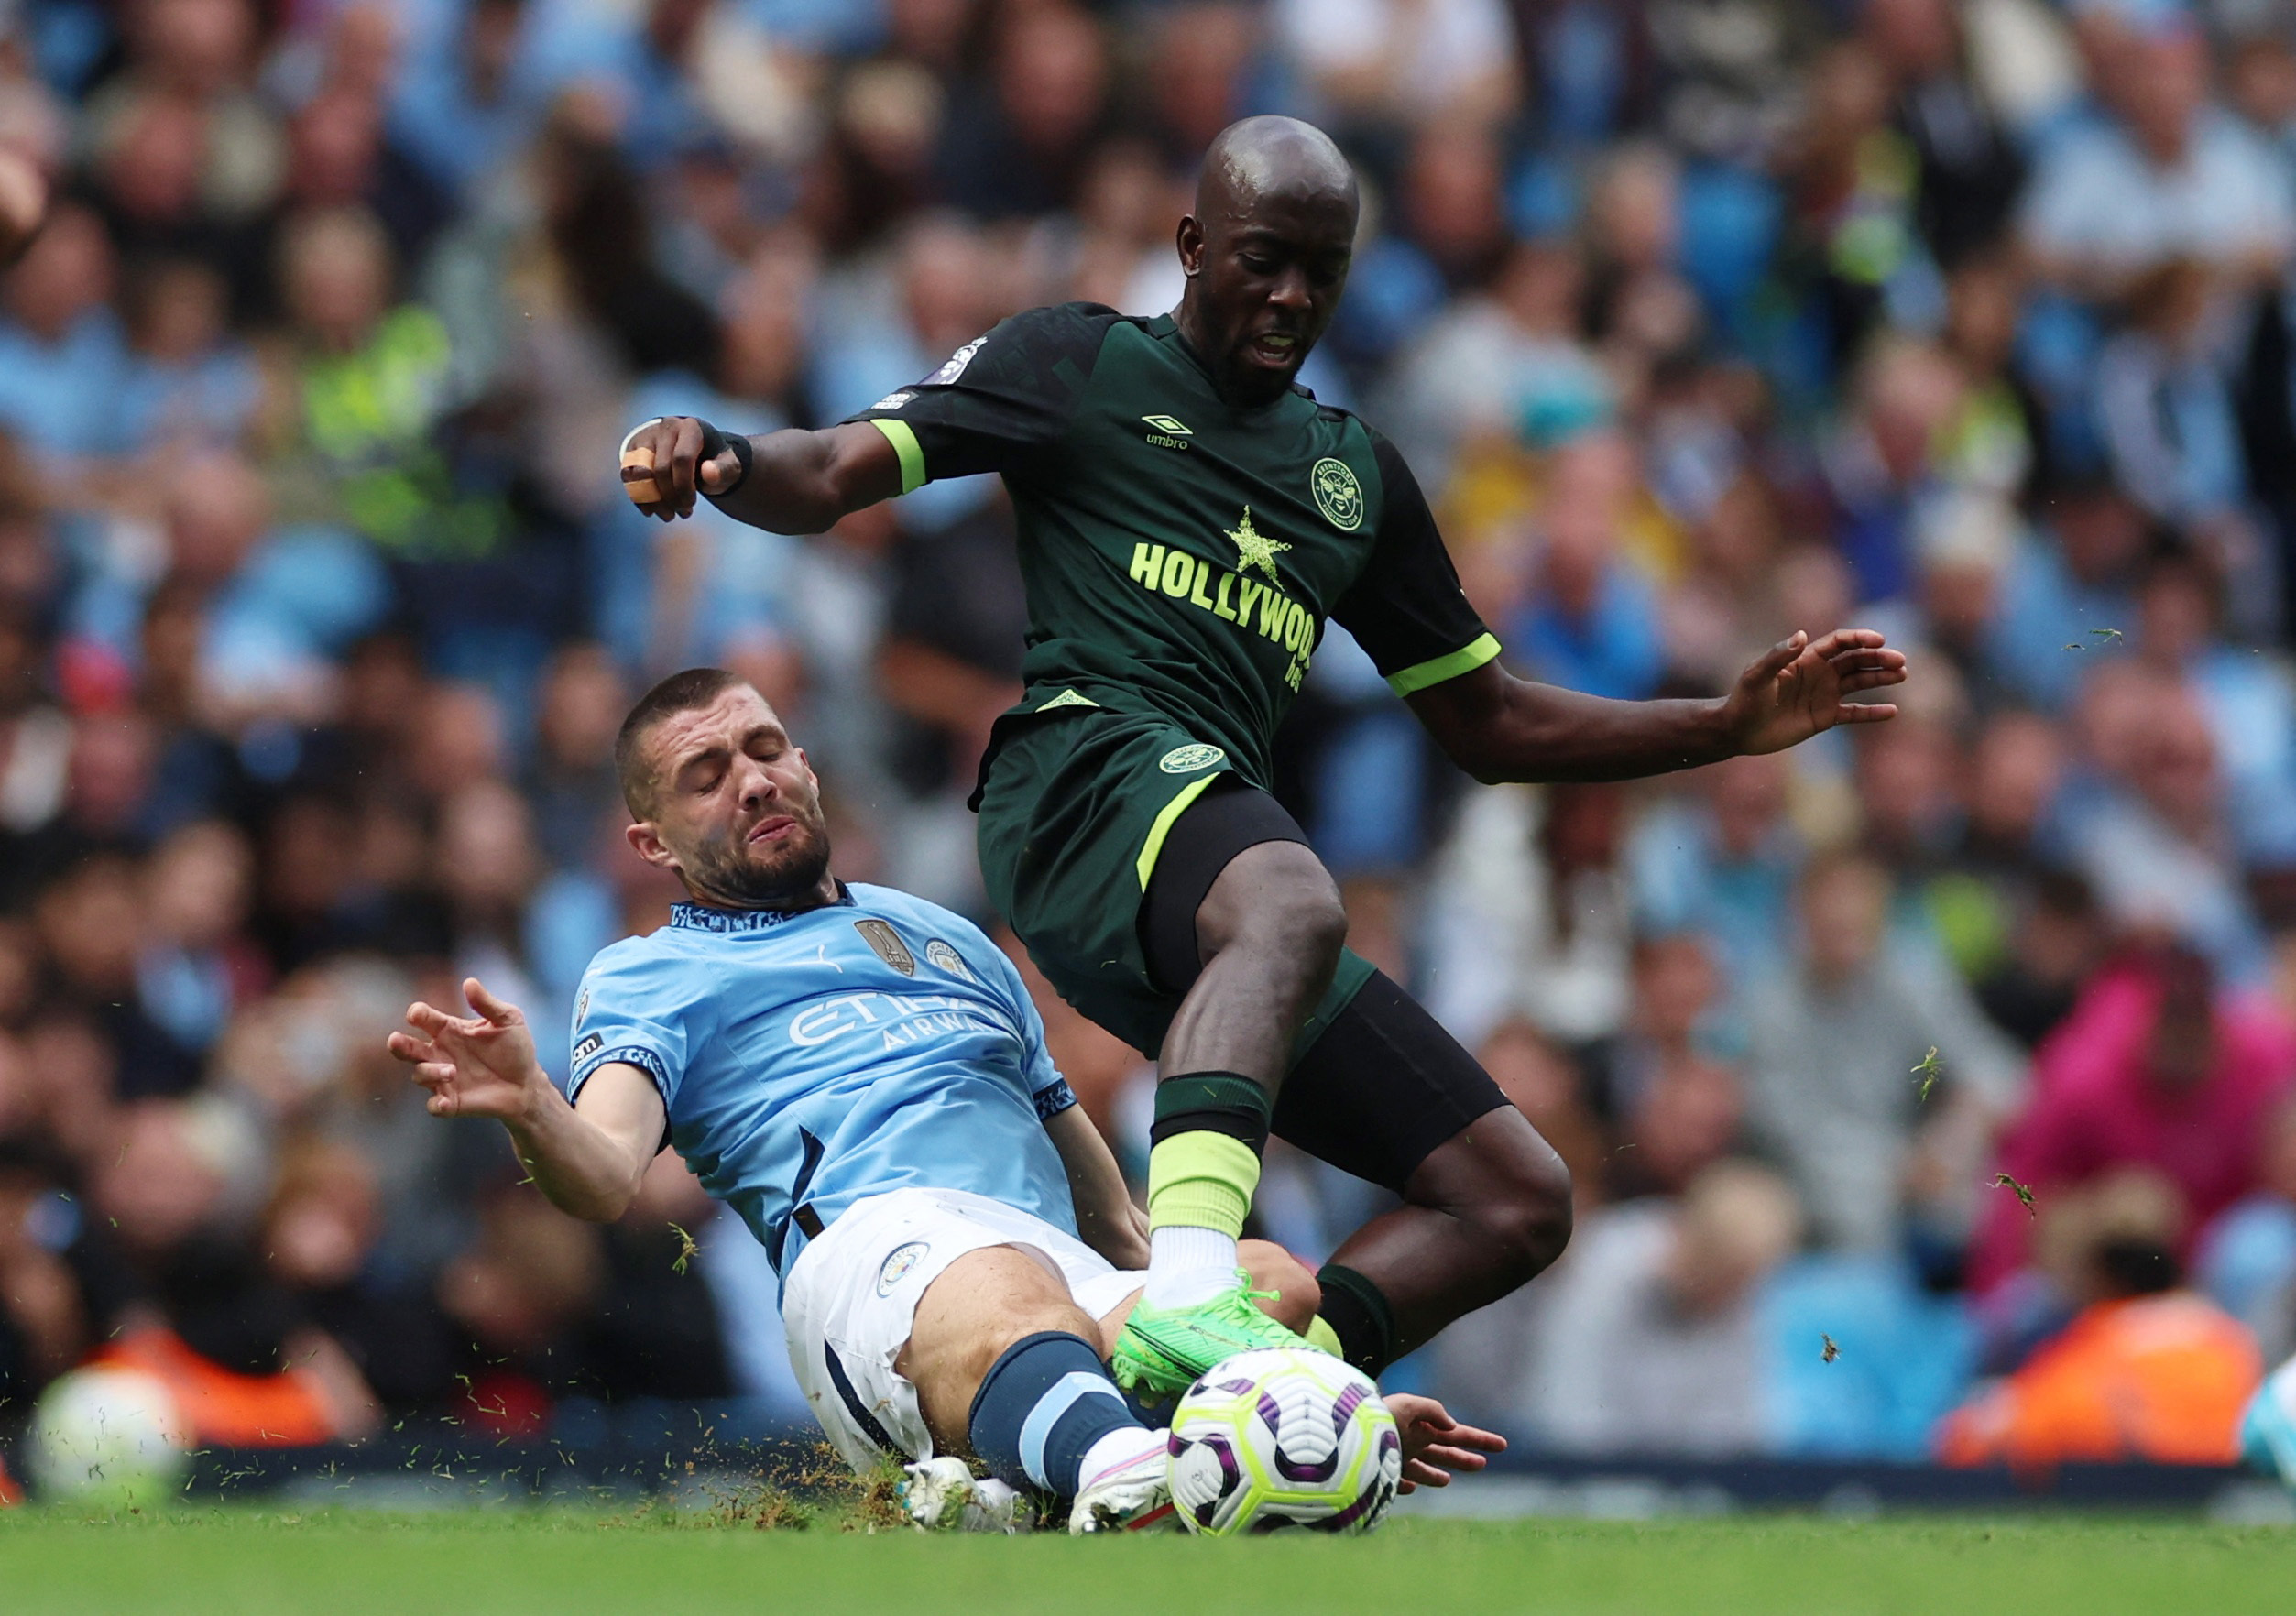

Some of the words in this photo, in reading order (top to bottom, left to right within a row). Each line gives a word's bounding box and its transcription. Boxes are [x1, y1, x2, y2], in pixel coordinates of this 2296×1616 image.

[1146, 433, 1188, 450] umbro
[1317, 462, 1355, 486] BRENTFORD
[1129, 542, 1315, 670] HOLLYWOO
[788, 992, 1006, 1047] ETIHA
